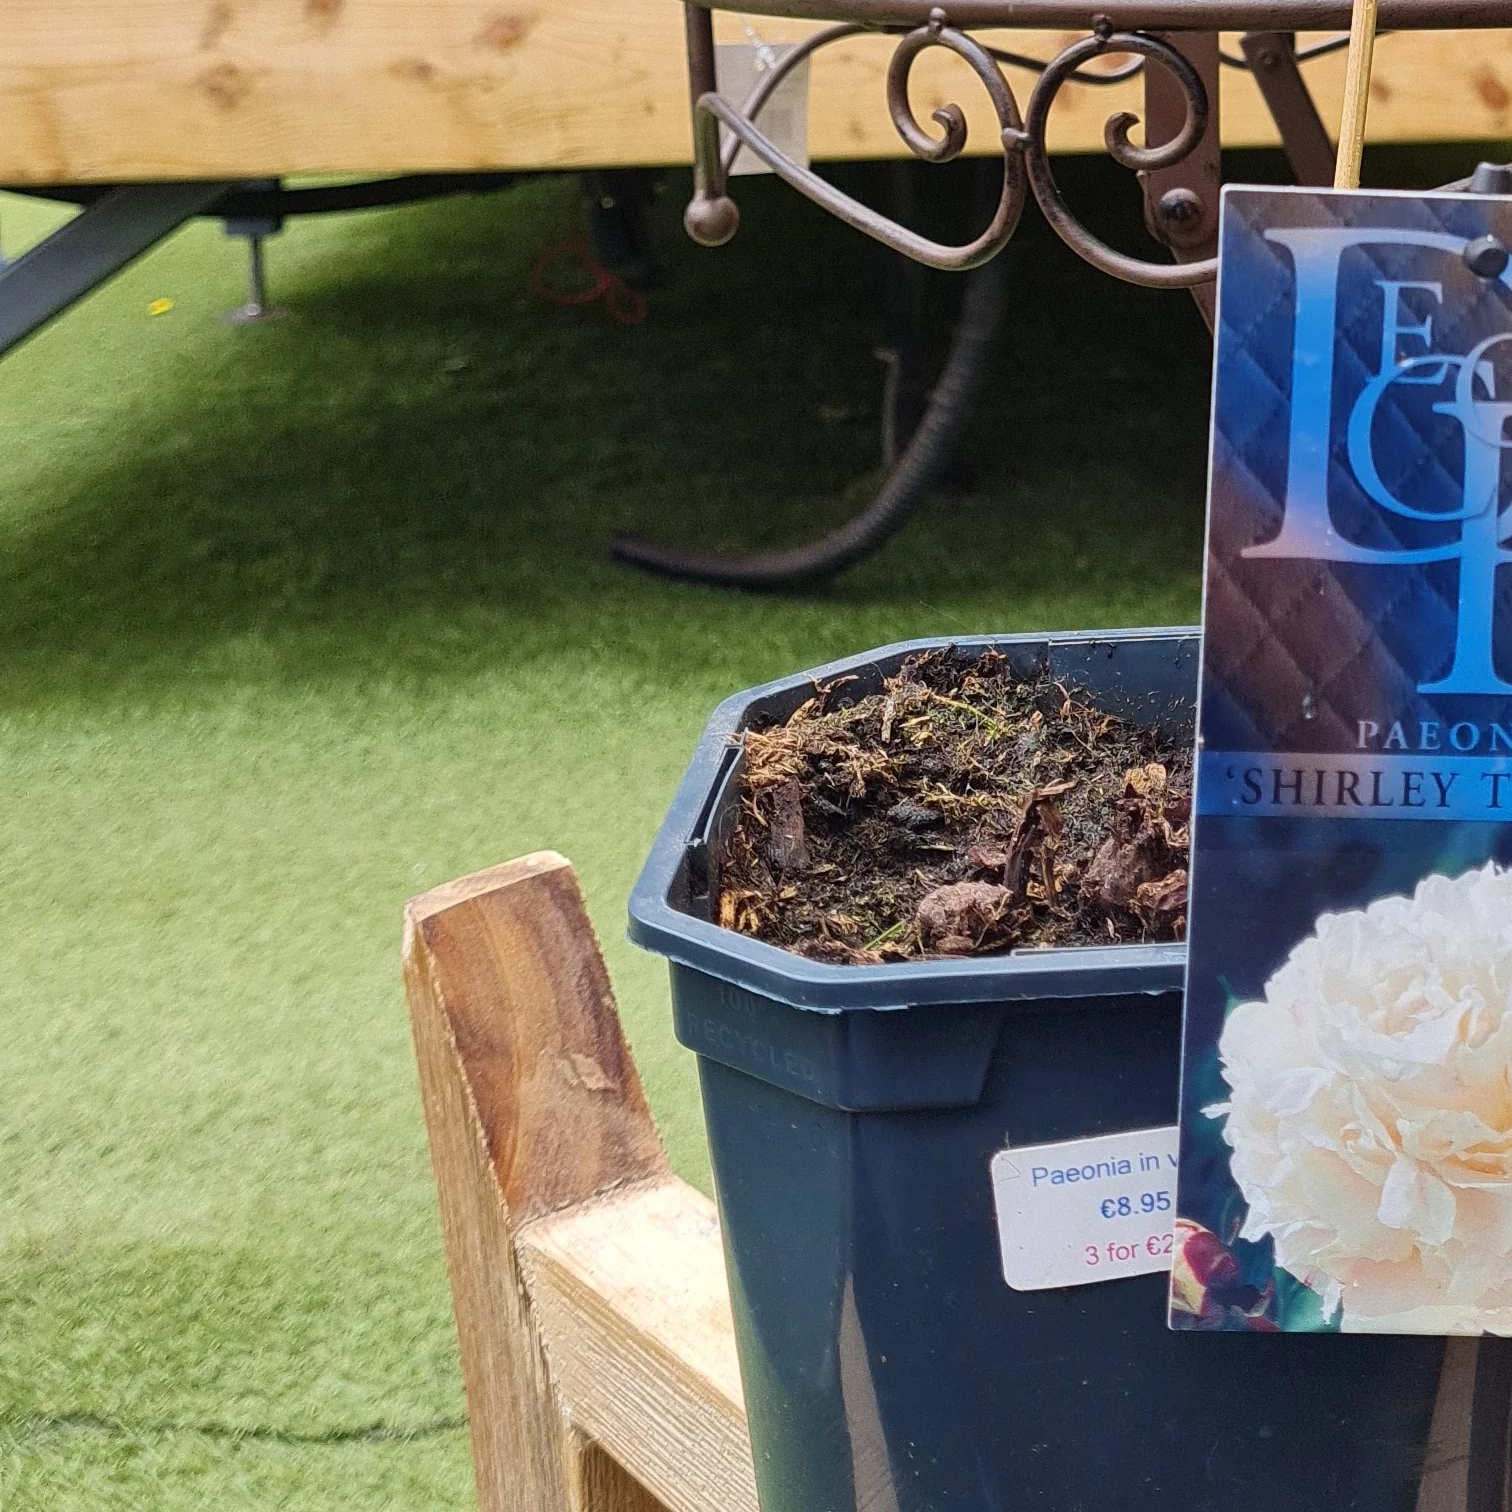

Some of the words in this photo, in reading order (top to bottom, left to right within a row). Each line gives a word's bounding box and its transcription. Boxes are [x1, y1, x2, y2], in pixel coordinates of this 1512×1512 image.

[1031, 1156, 1132, 1187] Paeonia
[1139, 1152, 1160, 1172] in
[1100, 1190, 1172, 1219] €8.95
[1085, 1245, 1100, 1266] 3
[1107, 1242, 1140, 1262] for
